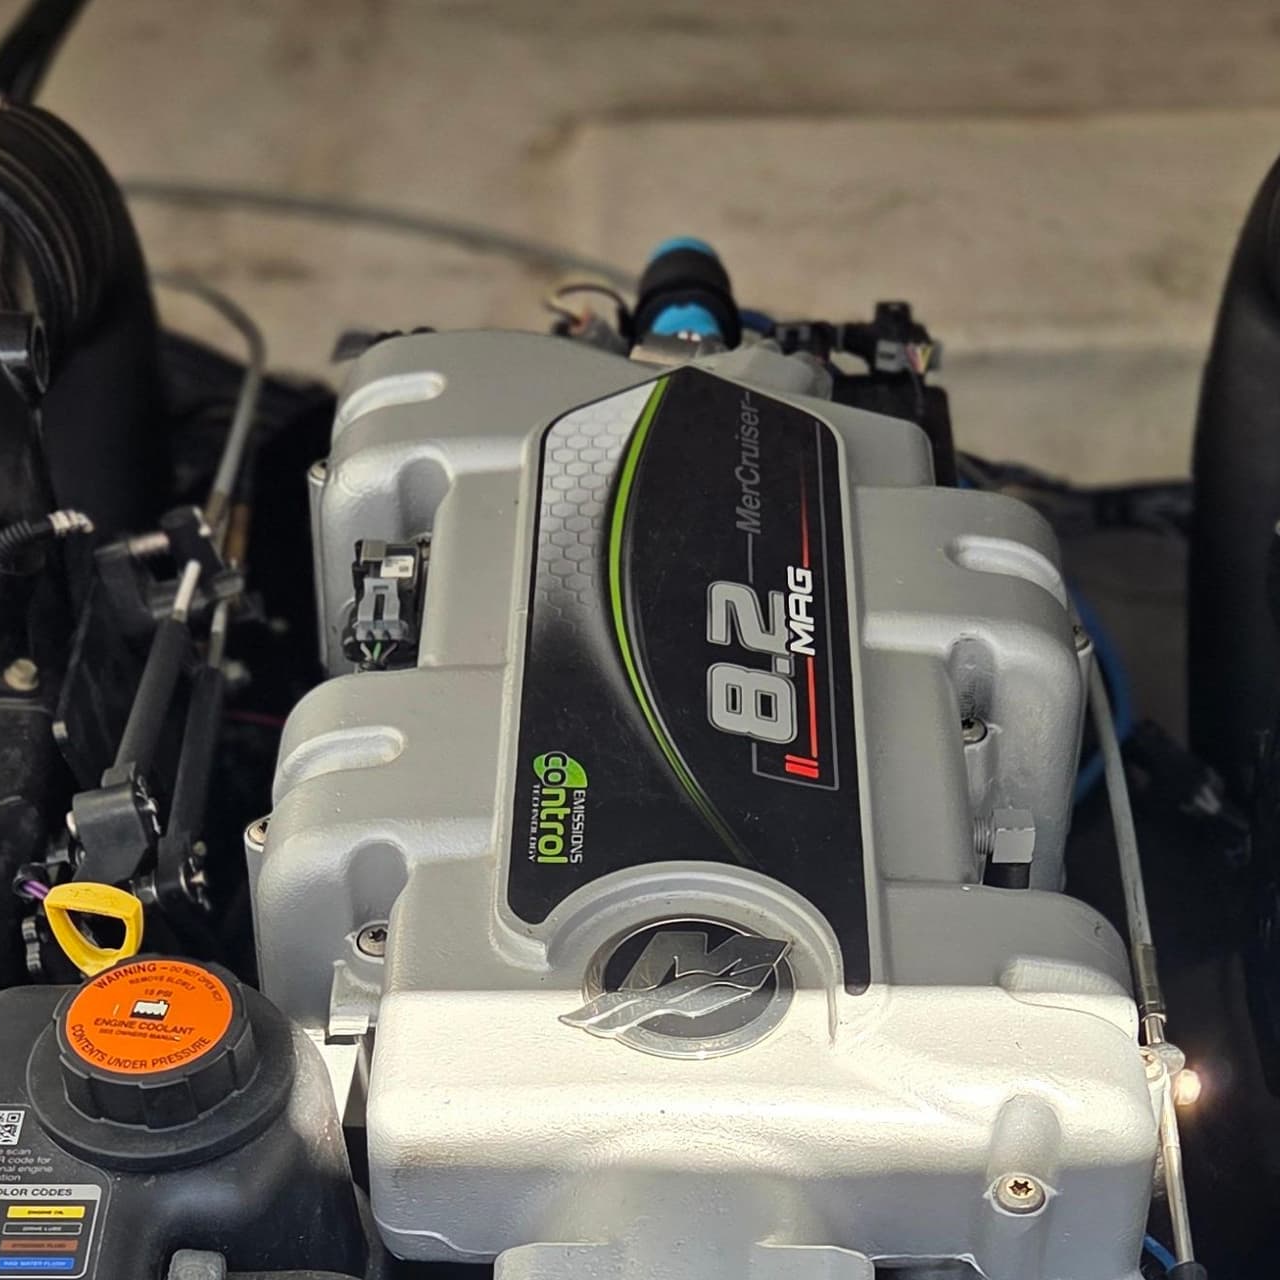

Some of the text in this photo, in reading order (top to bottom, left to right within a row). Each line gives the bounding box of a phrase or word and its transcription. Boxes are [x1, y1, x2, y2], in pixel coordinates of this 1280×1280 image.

[736, 405, 762, 535] MerCruiser
[787, 566, 815, 656] MAG
[706, 580, 798, 744] 8.2
[528, 784, 540, 862] TECHNOLOGY
[570, 790, 586, 863] EMISSIONS
[94, 963, 157, 990] WARNING
[184, 968, 198, 978] NOT
[71, 1023, 211, 1070] CONTENTS UNDER PRESSURE
[94, 1017, 195, 1035] ENGINE COOLANT
[18, 1166, 53, 1174] engine
[31, 1188, 72, 1196] CODES
